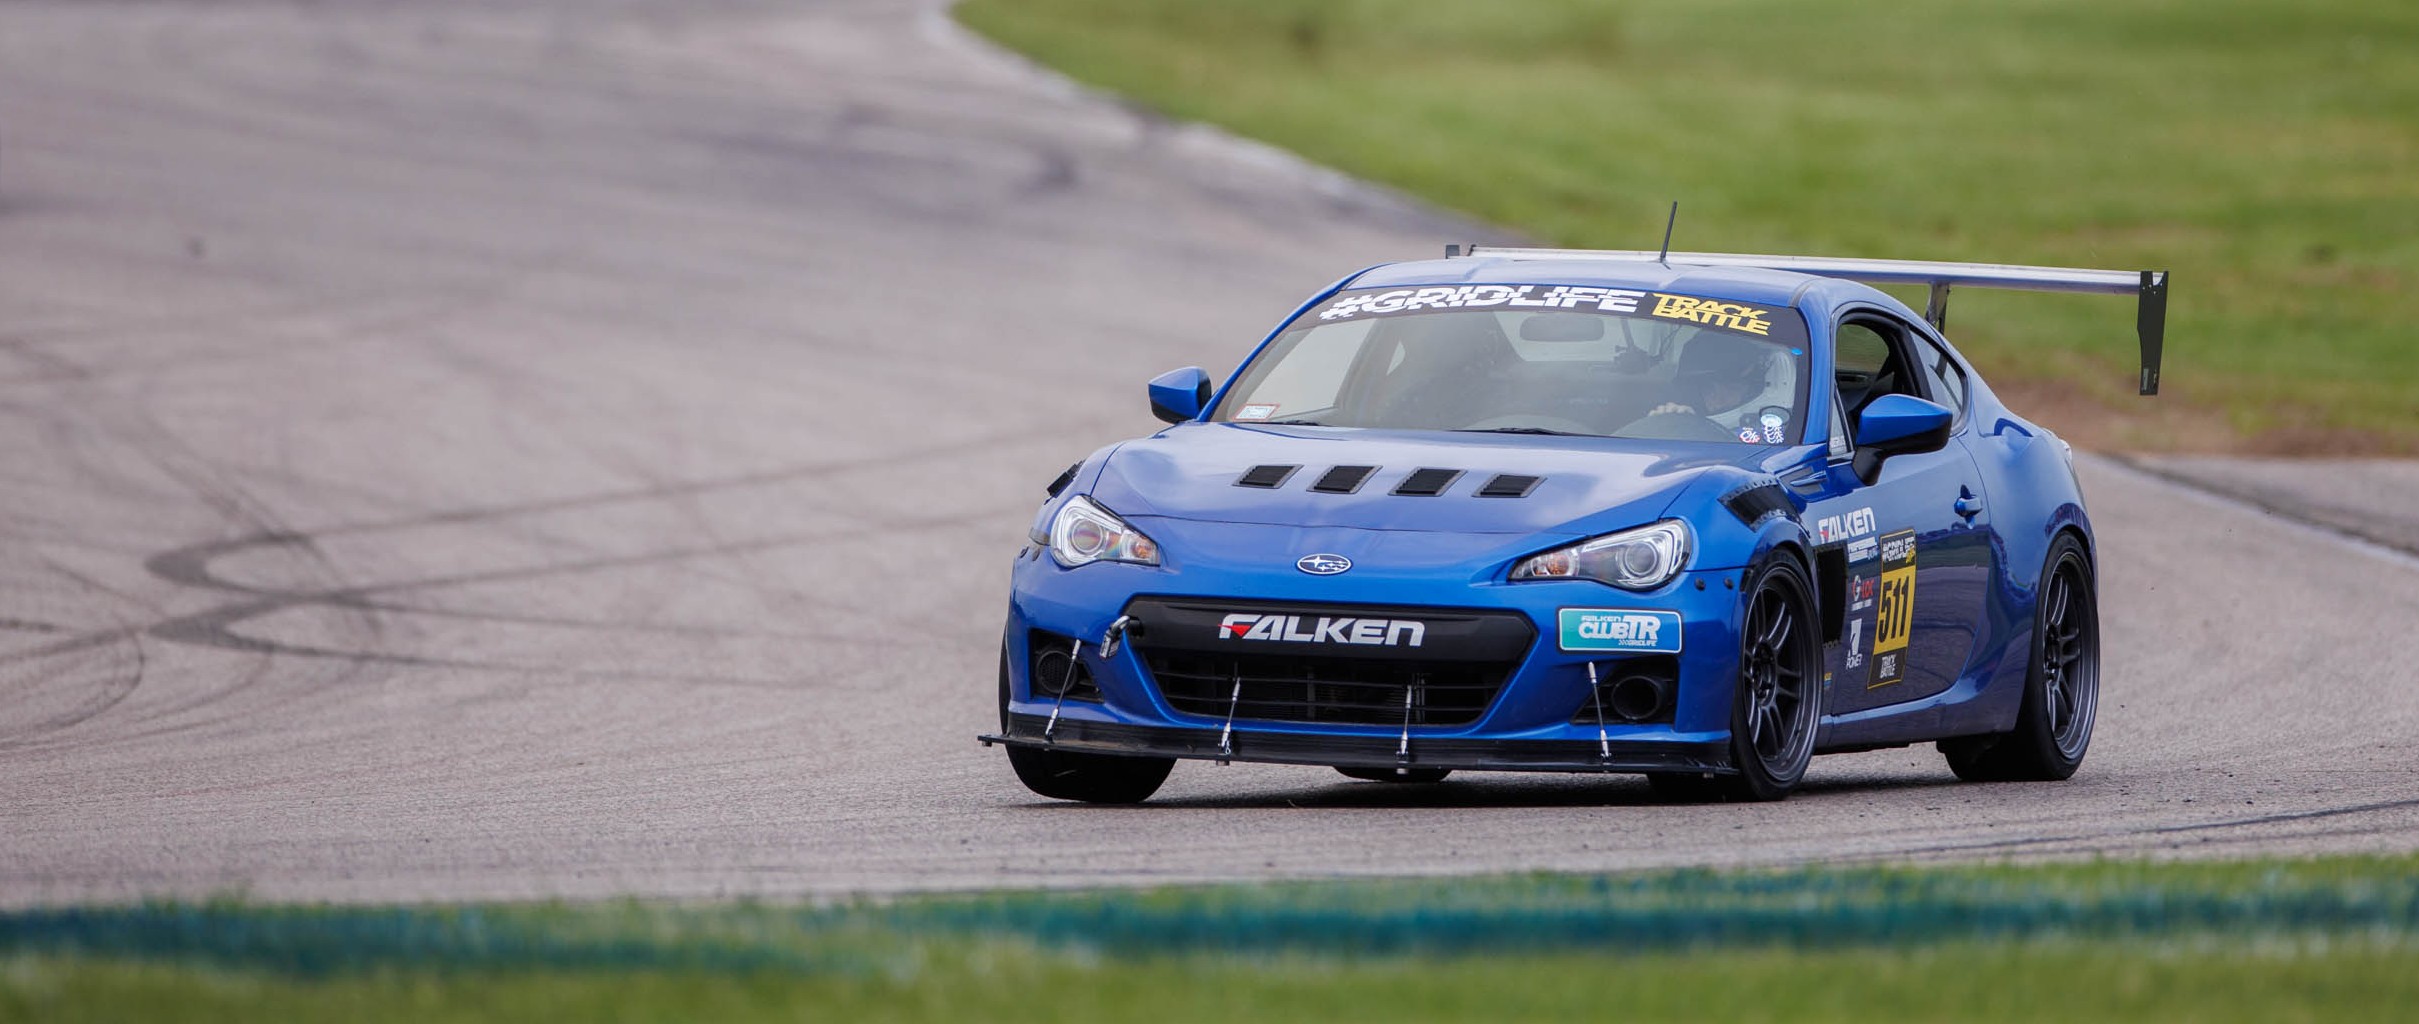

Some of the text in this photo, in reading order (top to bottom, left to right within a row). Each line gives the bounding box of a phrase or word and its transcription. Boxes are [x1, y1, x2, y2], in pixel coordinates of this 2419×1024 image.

[1319, 285, 1646, 320] #GRIDLIFE
[1652, 293, 1768, 319] TRACK
[1652, 306, 1771, 335] BATTLE
[1818, 506, 1876, 545] FALKEN
[1878, 575, 1909, 643] 511
[1218, 613, 1425, 647] FALKEN
